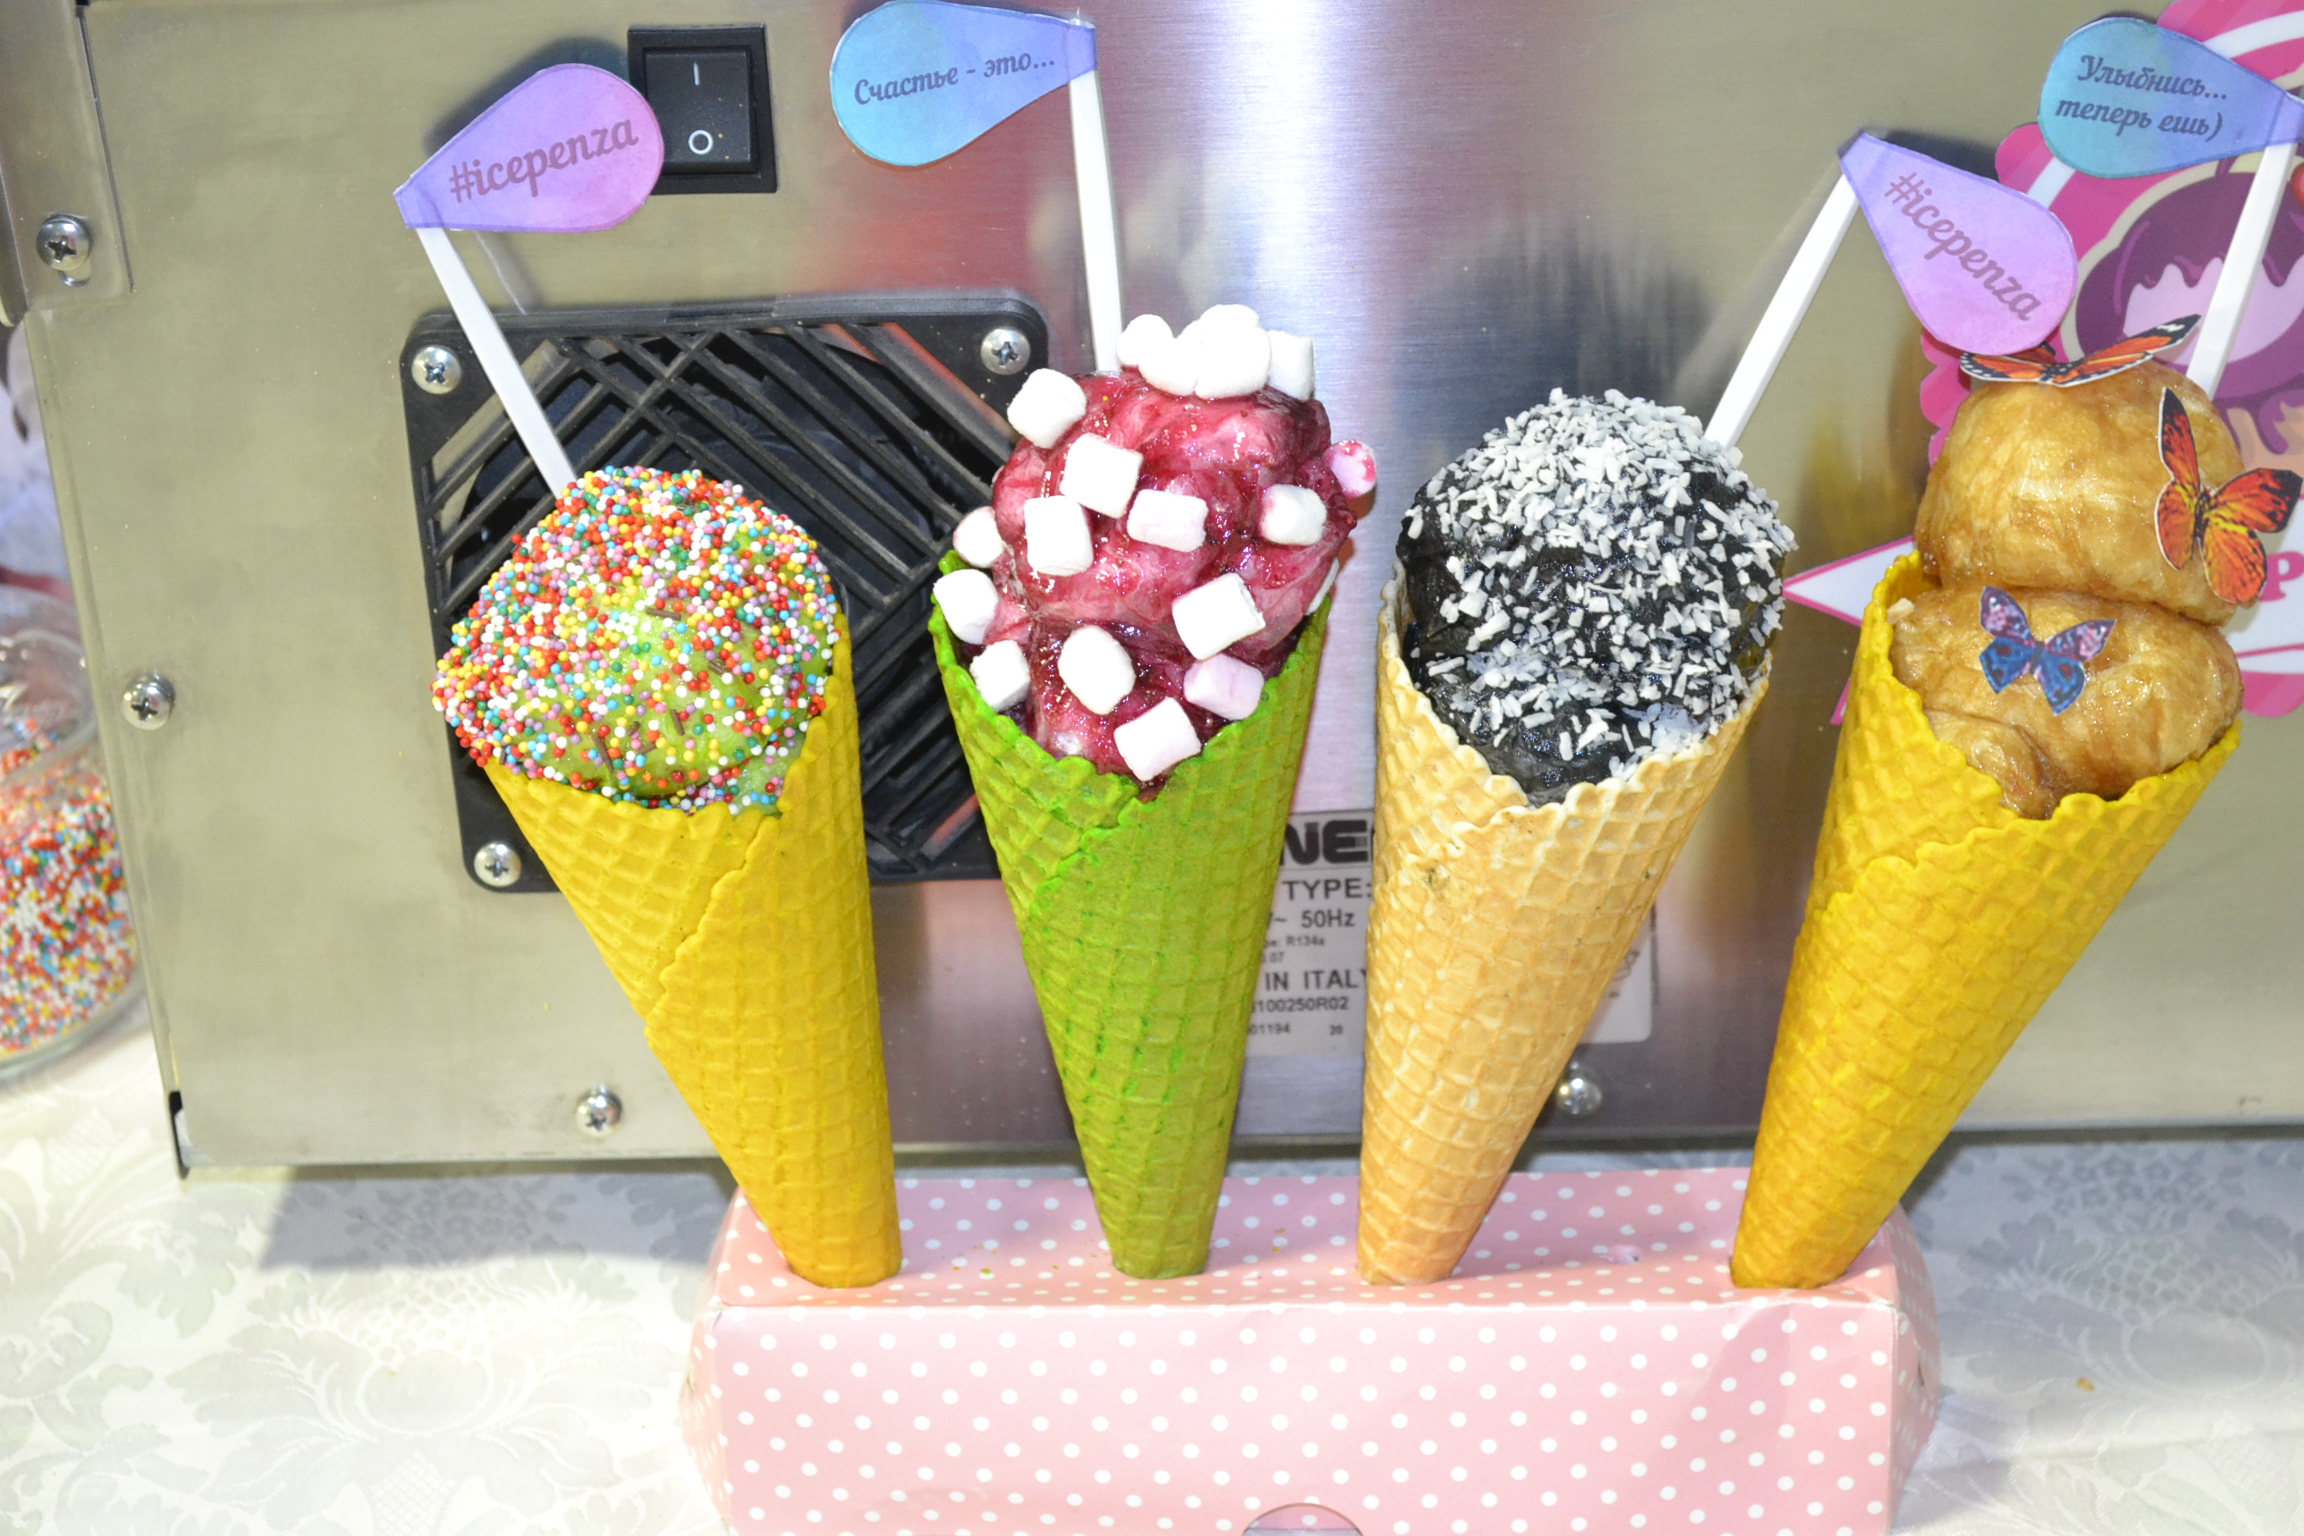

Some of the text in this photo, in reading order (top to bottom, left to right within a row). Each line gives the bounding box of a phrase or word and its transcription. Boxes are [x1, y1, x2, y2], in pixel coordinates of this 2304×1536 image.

[854, 67, 959, 105] Счастье
[983, 53, 1055, 78] это...
[2077, 55, 2227, 100] Улыбнись...
[2055, 99, 2223, 142] теперь ешь)
[449, 119, 639, 203] #icepenza
[1884, 172, 2042, 322] #icepenza
[1281, 877, 1372, 900] TYPE:
[1301, 909, 1355, 928] 50Hz
[1265, 971, 1289, 991] IN
